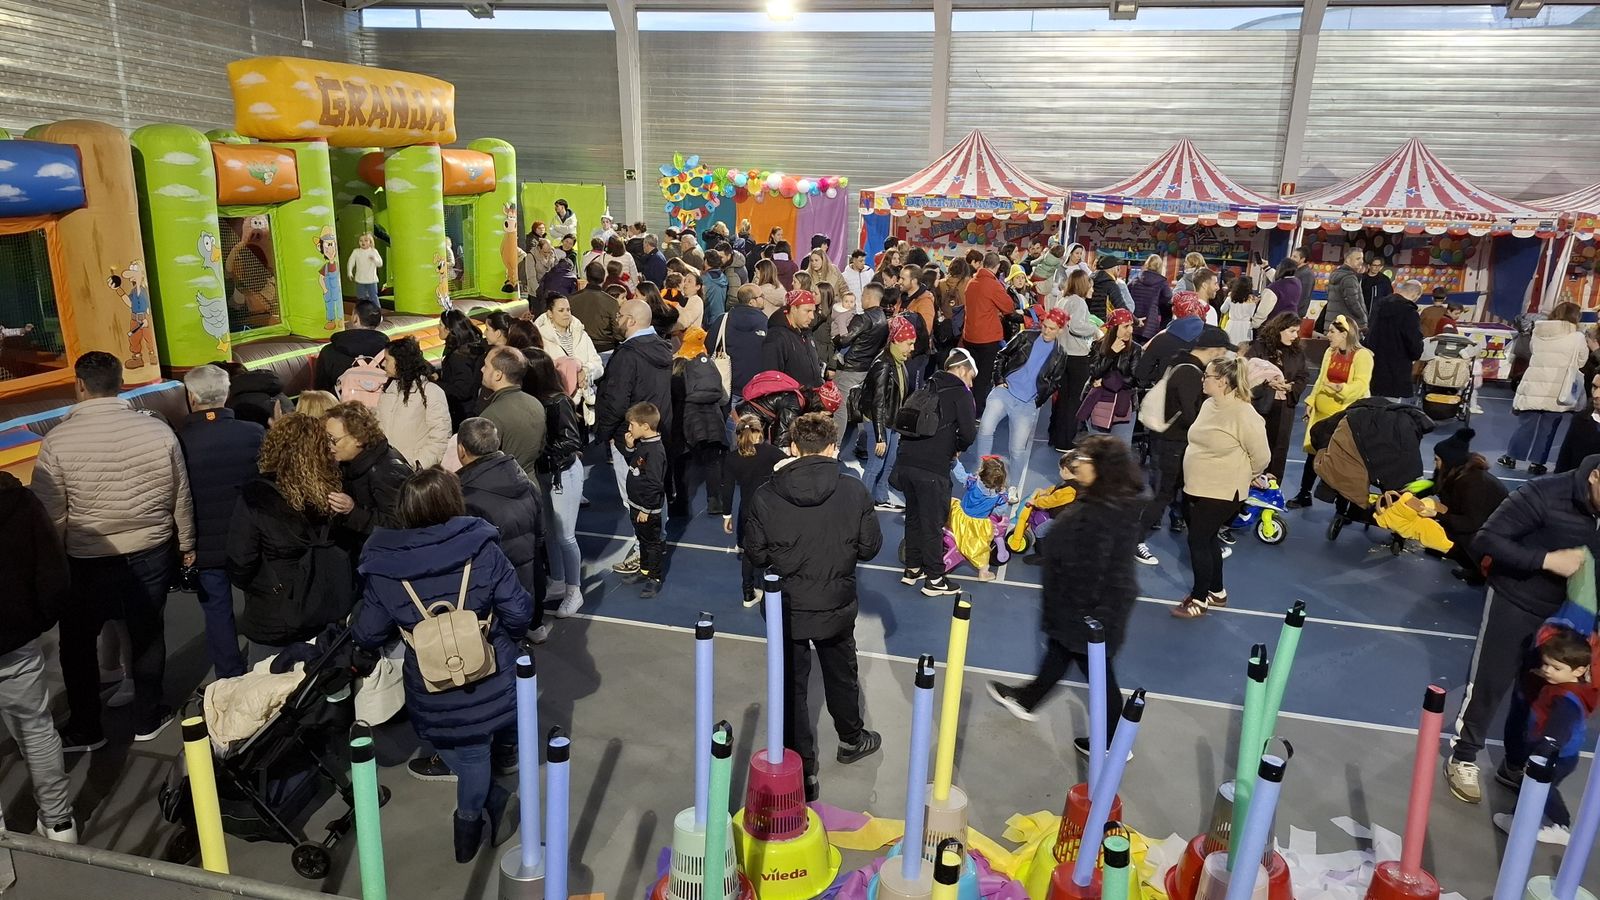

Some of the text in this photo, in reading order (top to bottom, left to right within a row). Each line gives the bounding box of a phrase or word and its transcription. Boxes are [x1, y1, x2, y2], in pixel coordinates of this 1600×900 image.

[315, 76, 447, 131] GRANJA
[905, 197, 1014, 210] DIVERTILANDIA
[1360, 207, 1498, 223] DIVERTILANDIA
[761, 868, 807, 881] vileda
